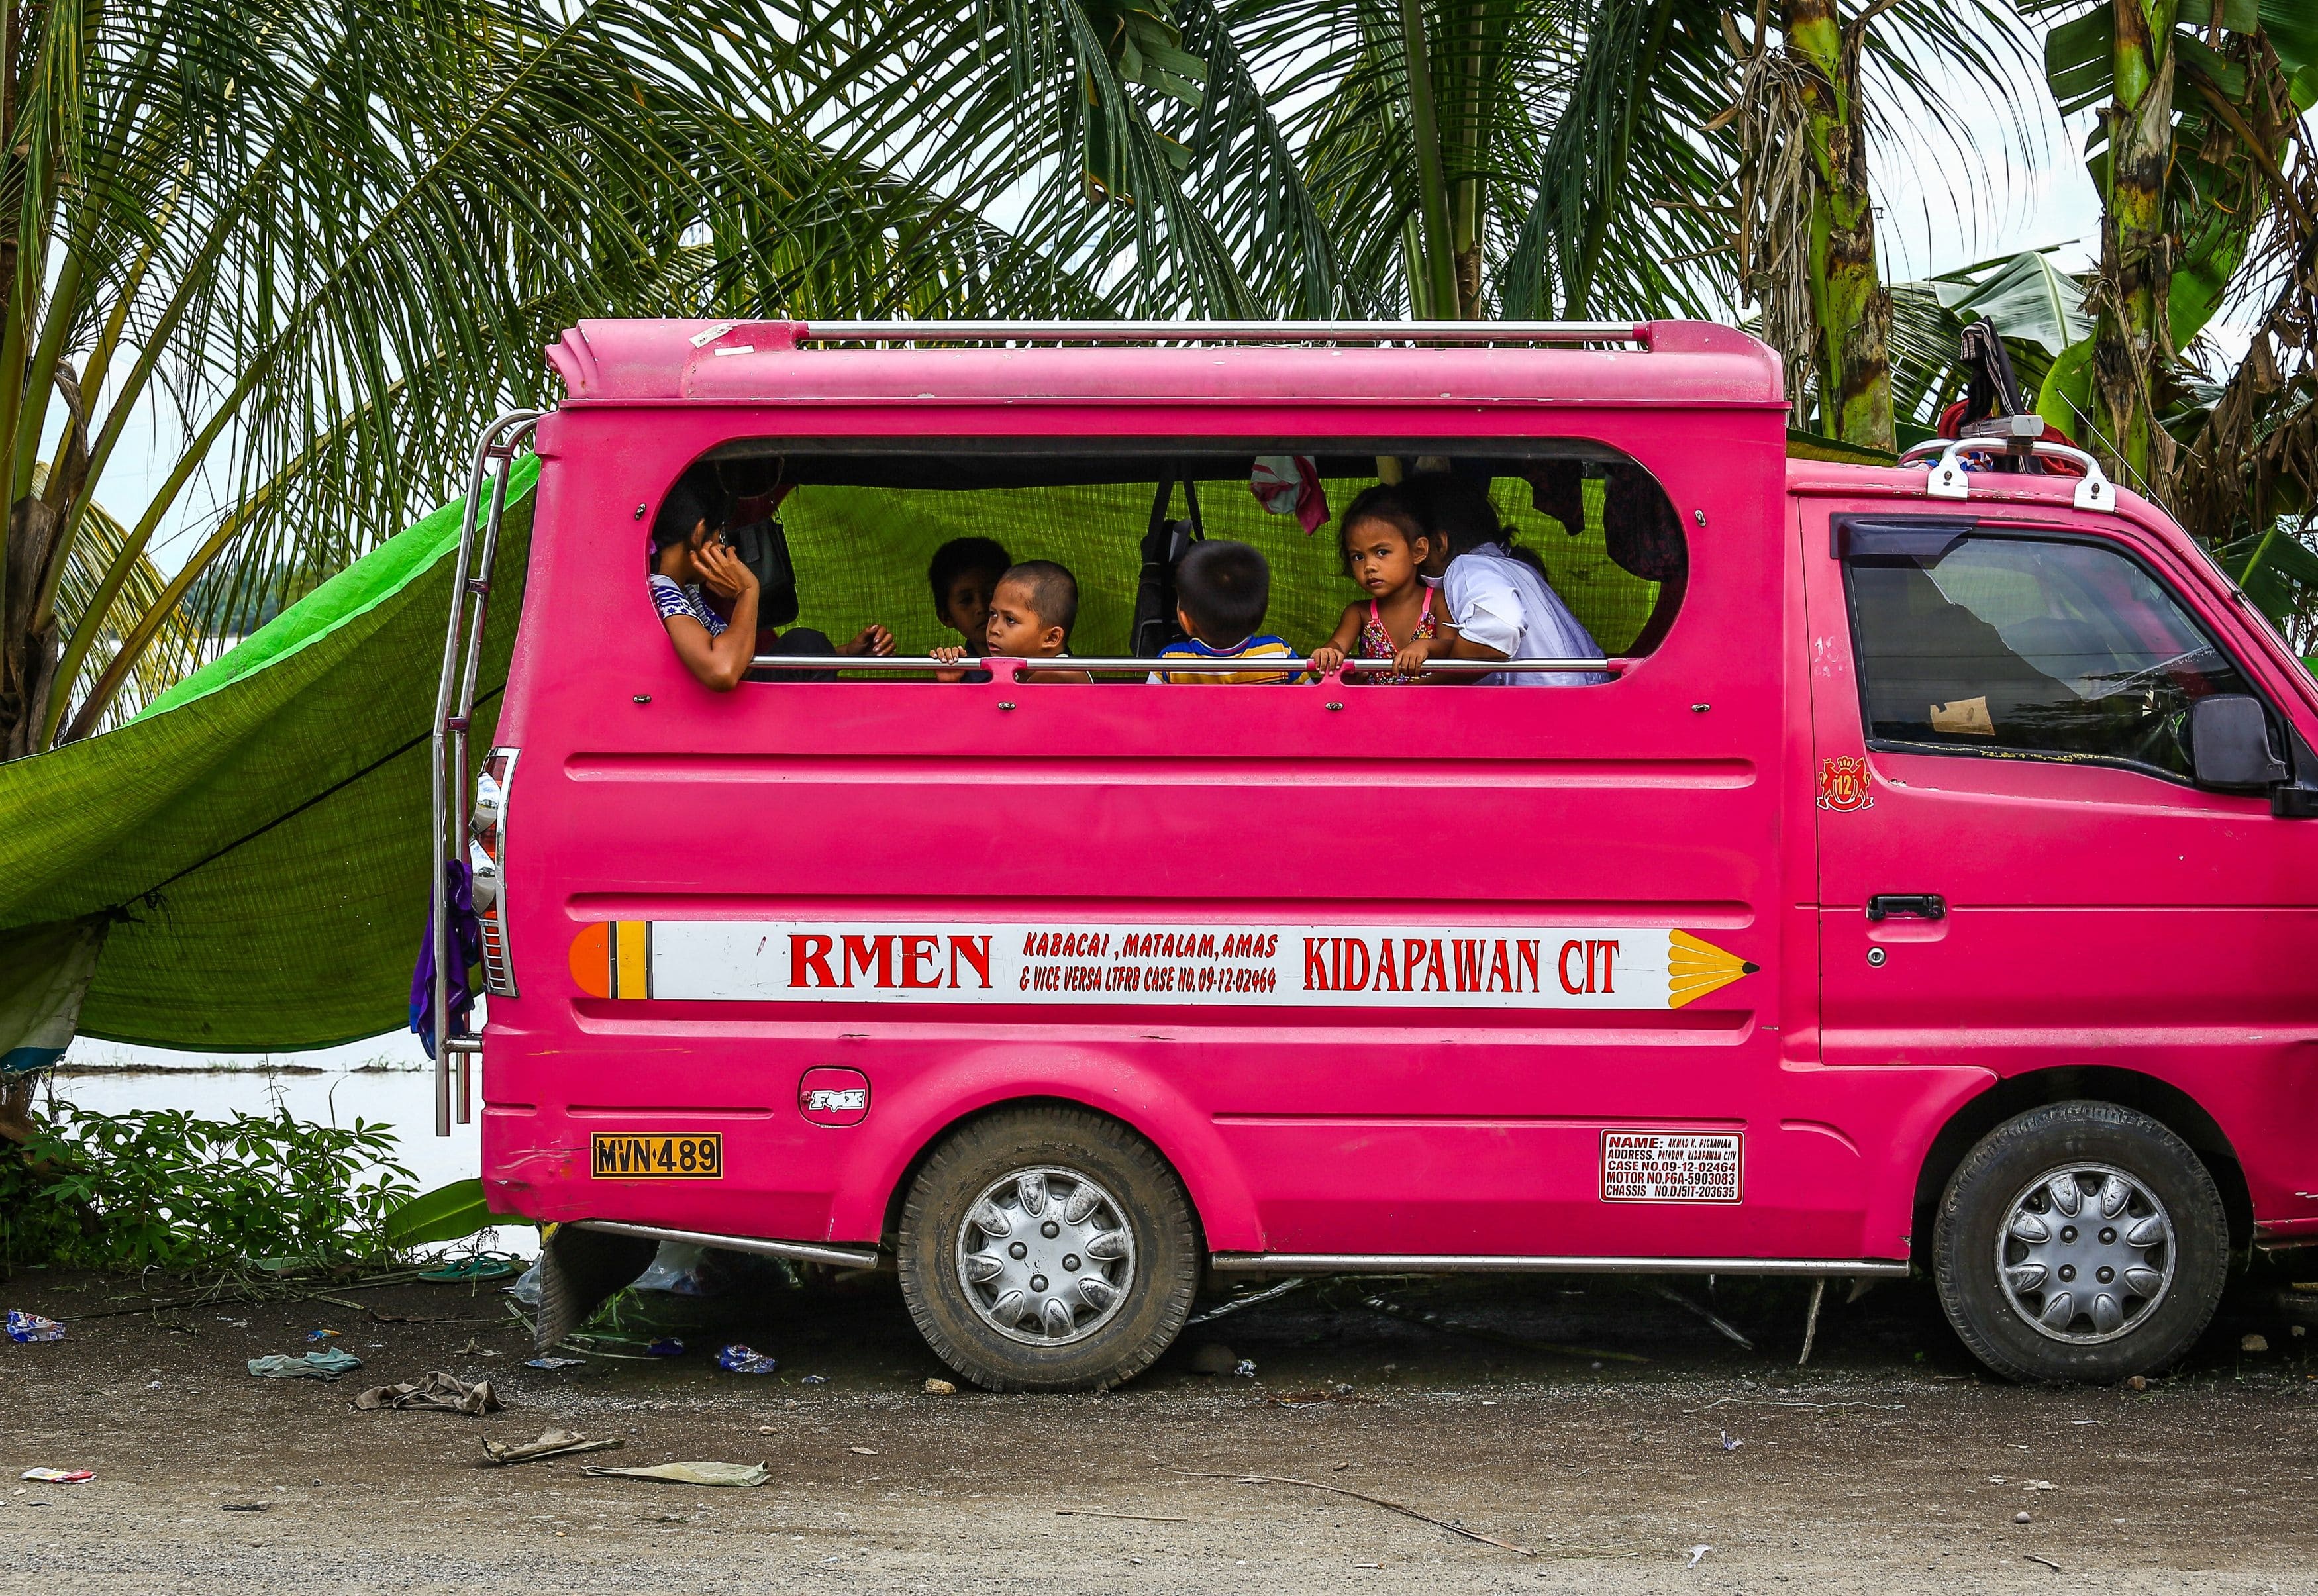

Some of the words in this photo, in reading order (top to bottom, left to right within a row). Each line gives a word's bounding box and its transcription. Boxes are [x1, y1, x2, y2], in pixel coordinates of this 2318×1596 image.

[1837, 775, 1852, 795] 12
[787, 934, 993, 989] RMEN
[1302, 937, 1540, 993] KIDAPAWAN
[1558, 939, 1621, 995] CIT
[1019, 965, 1030, 991] &
[1033, 966, 1061, 992] VICE
[1064, 966, 1102, 992] VERSA
[1105, 966, 1141, 993] LTFRB
[1144, 966, 1176, 993] CASE
[1609, 1136, 1664, 1149] NAME:
[1687, 1150, 1722, 1161] KIDAPAWAN
[1723, 1150, 1737, 1161] CITY
[1607, 1160, 1639, 1171] CASE
[1607, 1171, 1644, 1184] MOTOR
[1606, 1184, 1647, 1197] CHASSIS
